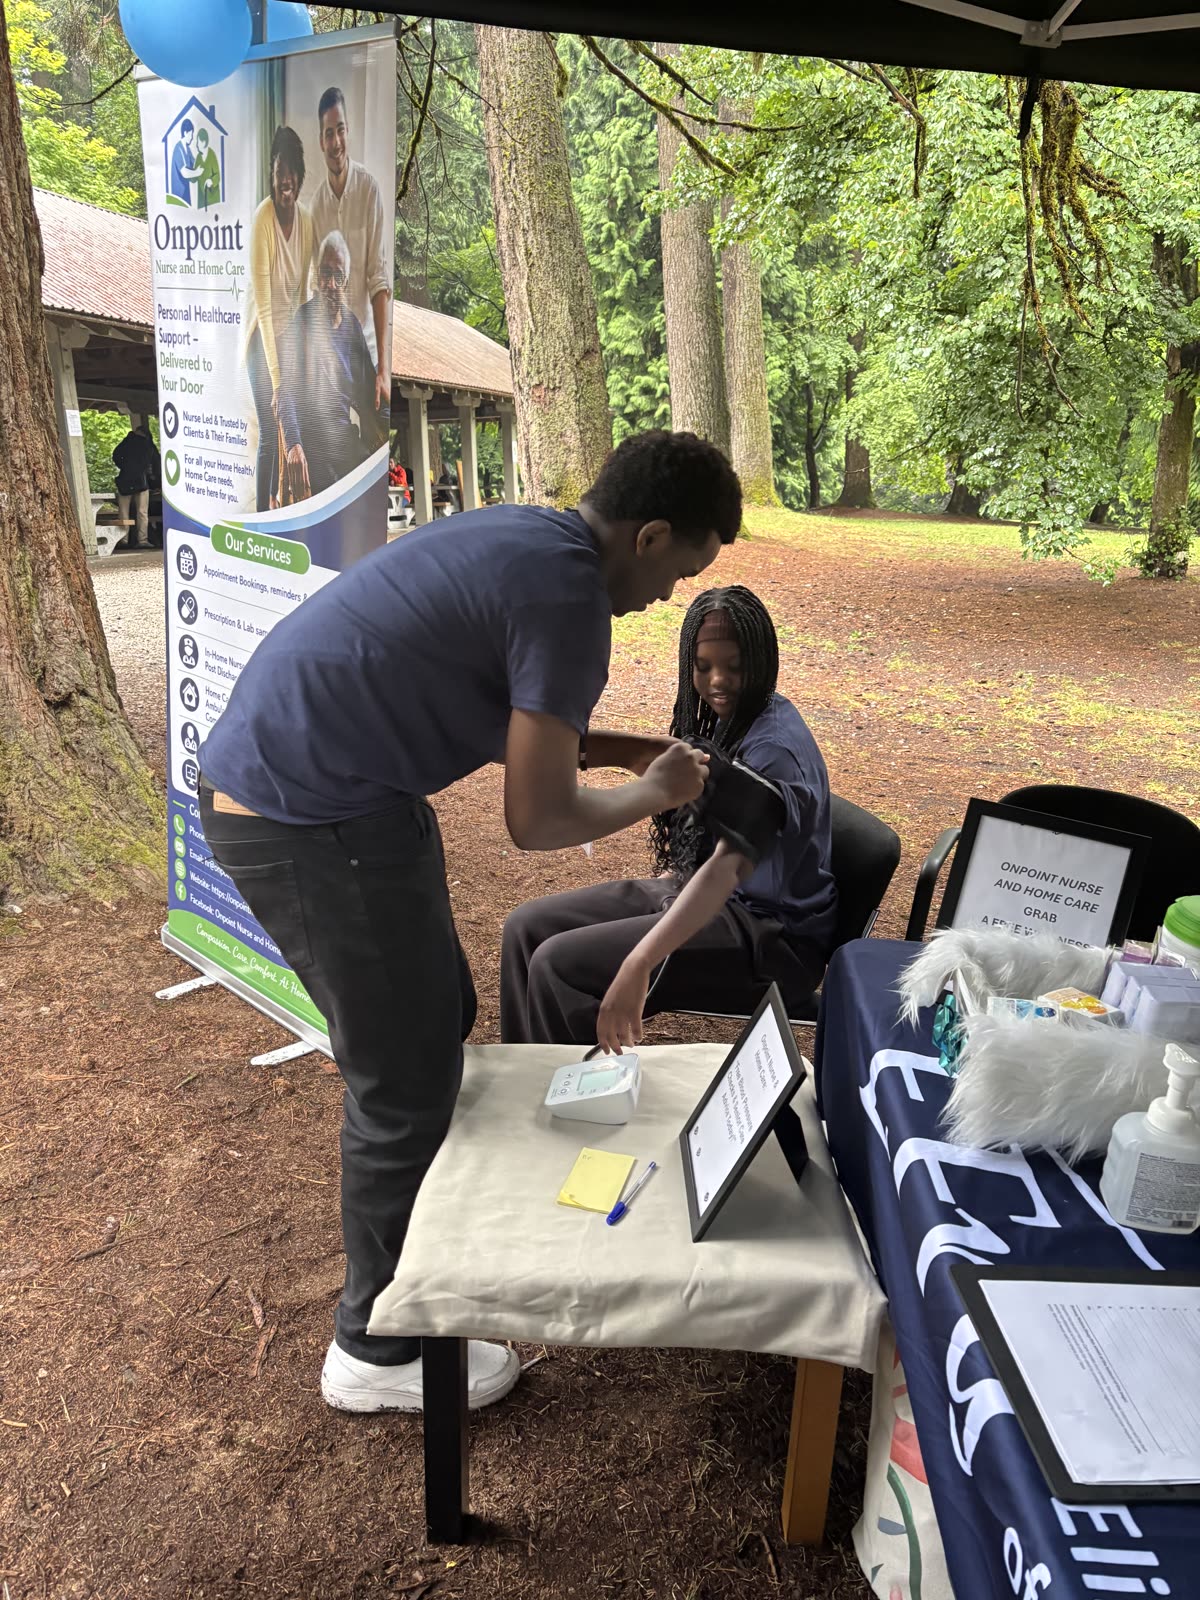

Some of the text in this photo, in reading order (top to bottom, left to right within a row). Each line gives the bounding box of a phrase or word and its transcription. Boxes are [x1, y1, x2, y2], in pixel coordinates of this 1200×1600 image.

[154, 214, 244, 260] Onpoint
[156, 260, 245, 276] Nurse and Home Care
[158, 304, 240, 324] Personal Healthcare
[159, 327, 190, 348] Support
[160, 352, 212, 372] Delivered to
[161, 374, 204, 394] Your Door
[183, 410, 248, 432] Nurse Led & Trusted by
[184, 426, 247, 446] Clients & Their Families
[184, 454, 194, 464] For
[204, 459, 216, 469] your
[217, 460, 232, 472] Home
[185, 468, 202, 480] Home
[204, 472, 216, 482] Care
[185, 482, 195, 493] We
[196, 488, 205, 496] are
[207, 486, 218, 497] here
[225, 533, 291, 565] Our Services
[204, 565, 238, 584] Appointment
[240, 576, 269, 594] Bookings,
[270, 587, 301, 602] reminders
[205, 608, 236, 627] Prescription
[237, 620, 241, 629] &
[243, 621, 254, 633] Lab
[205, 647, 227, 664] In-Home
[205, 661, 216, 673] Post
[205, 685, 220, 700] Home
[190, 870, 210, 890] Website:
[1001, 862, 1104, 896] ONPOINT NURSE
[994, 879, 1100, 913] AND HOME CARE
[190, 893, 214, 915] Facebook:
[215, 909, 236, 928] Onpoint
[237, 921, 252, 938] Nurse
[254, 935, 264, 945] and
[982, 915, 988, 924] A
[1024, 907, 1057, 923] GRAB
[279, 976, 289, 989] At
[1050, 1496, 1171, 1600] Eli
